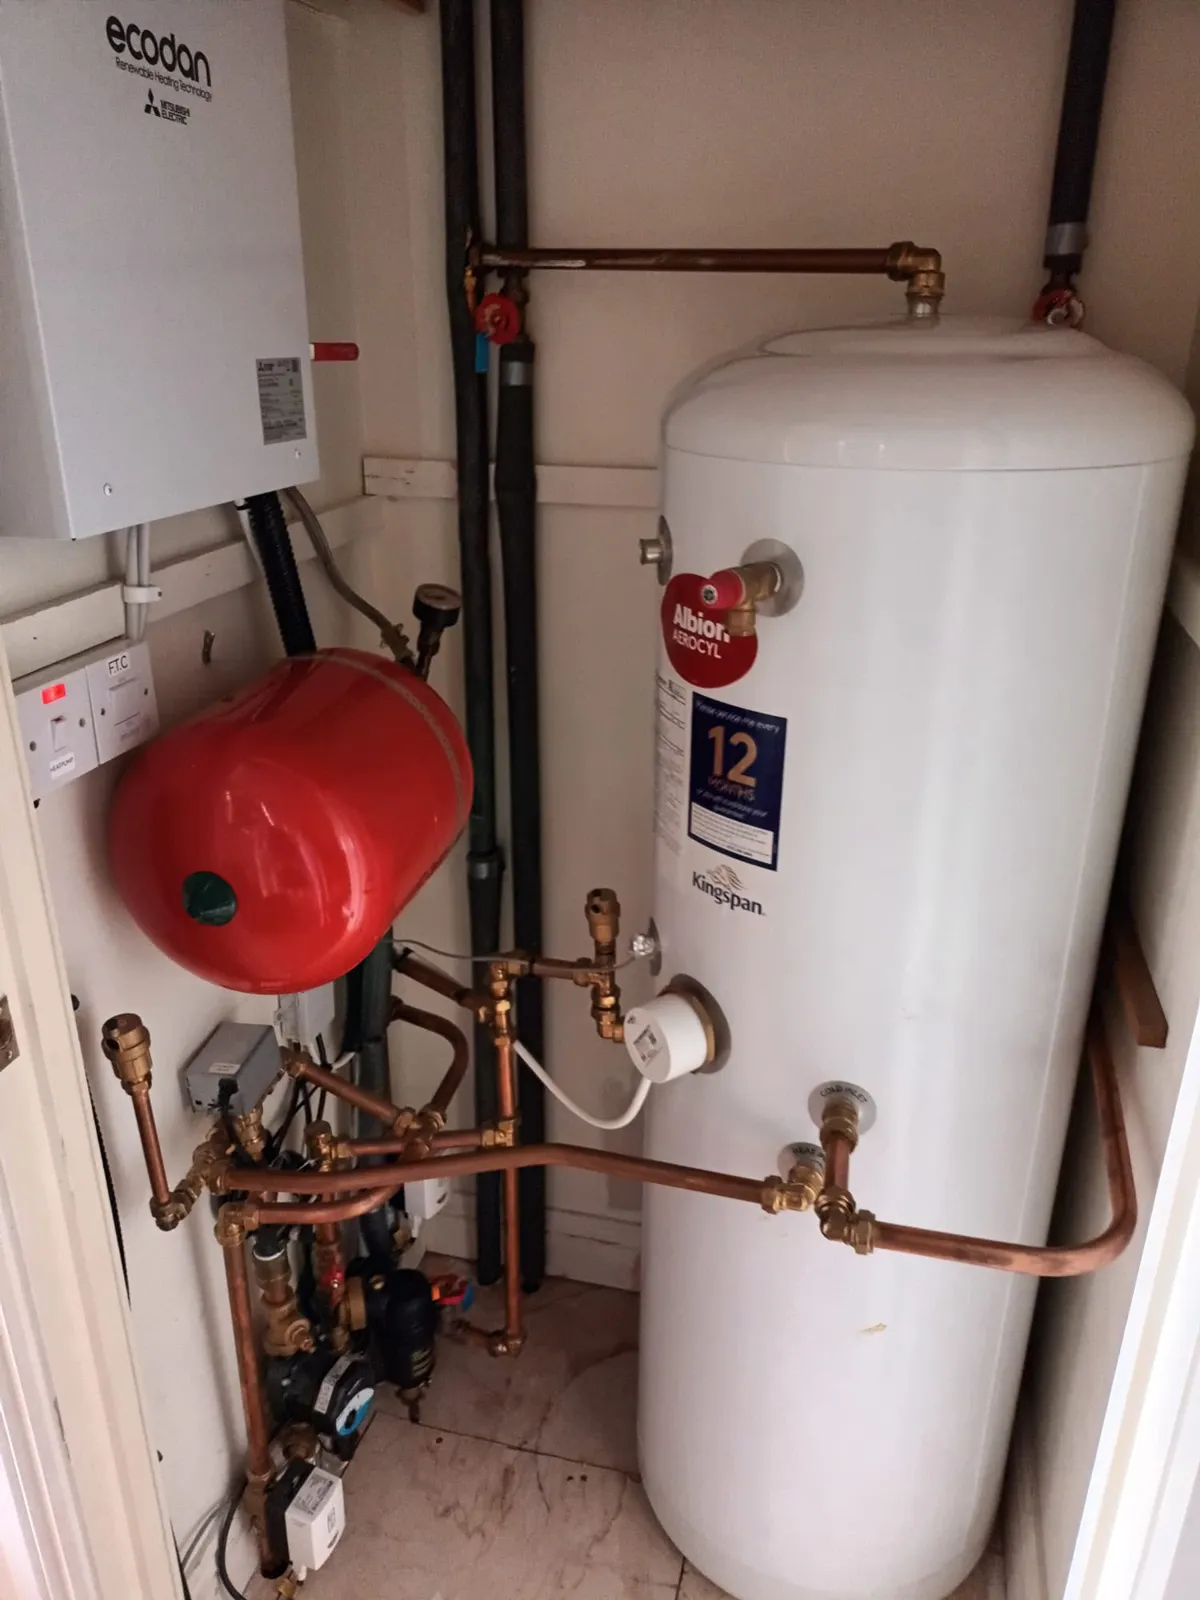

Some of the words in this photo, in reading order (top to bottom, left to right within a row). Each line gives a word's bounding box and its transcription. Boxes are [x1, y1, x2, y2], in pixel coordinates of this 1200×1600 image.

[106, 15, 211, 88] ecodan
[115, 57, 154, 80] Renewable
[155, 72, 179, 92] Heating
[180, 79, 212, 103] Technology
[161, 110, 187, 125] ELECTRIC
[672, 628, 722, 659] AEROCYL
[757, 721, 780, 735] every
[707, 725, 757, 788] 12
[692, 871, 763, 916] Kingspan
